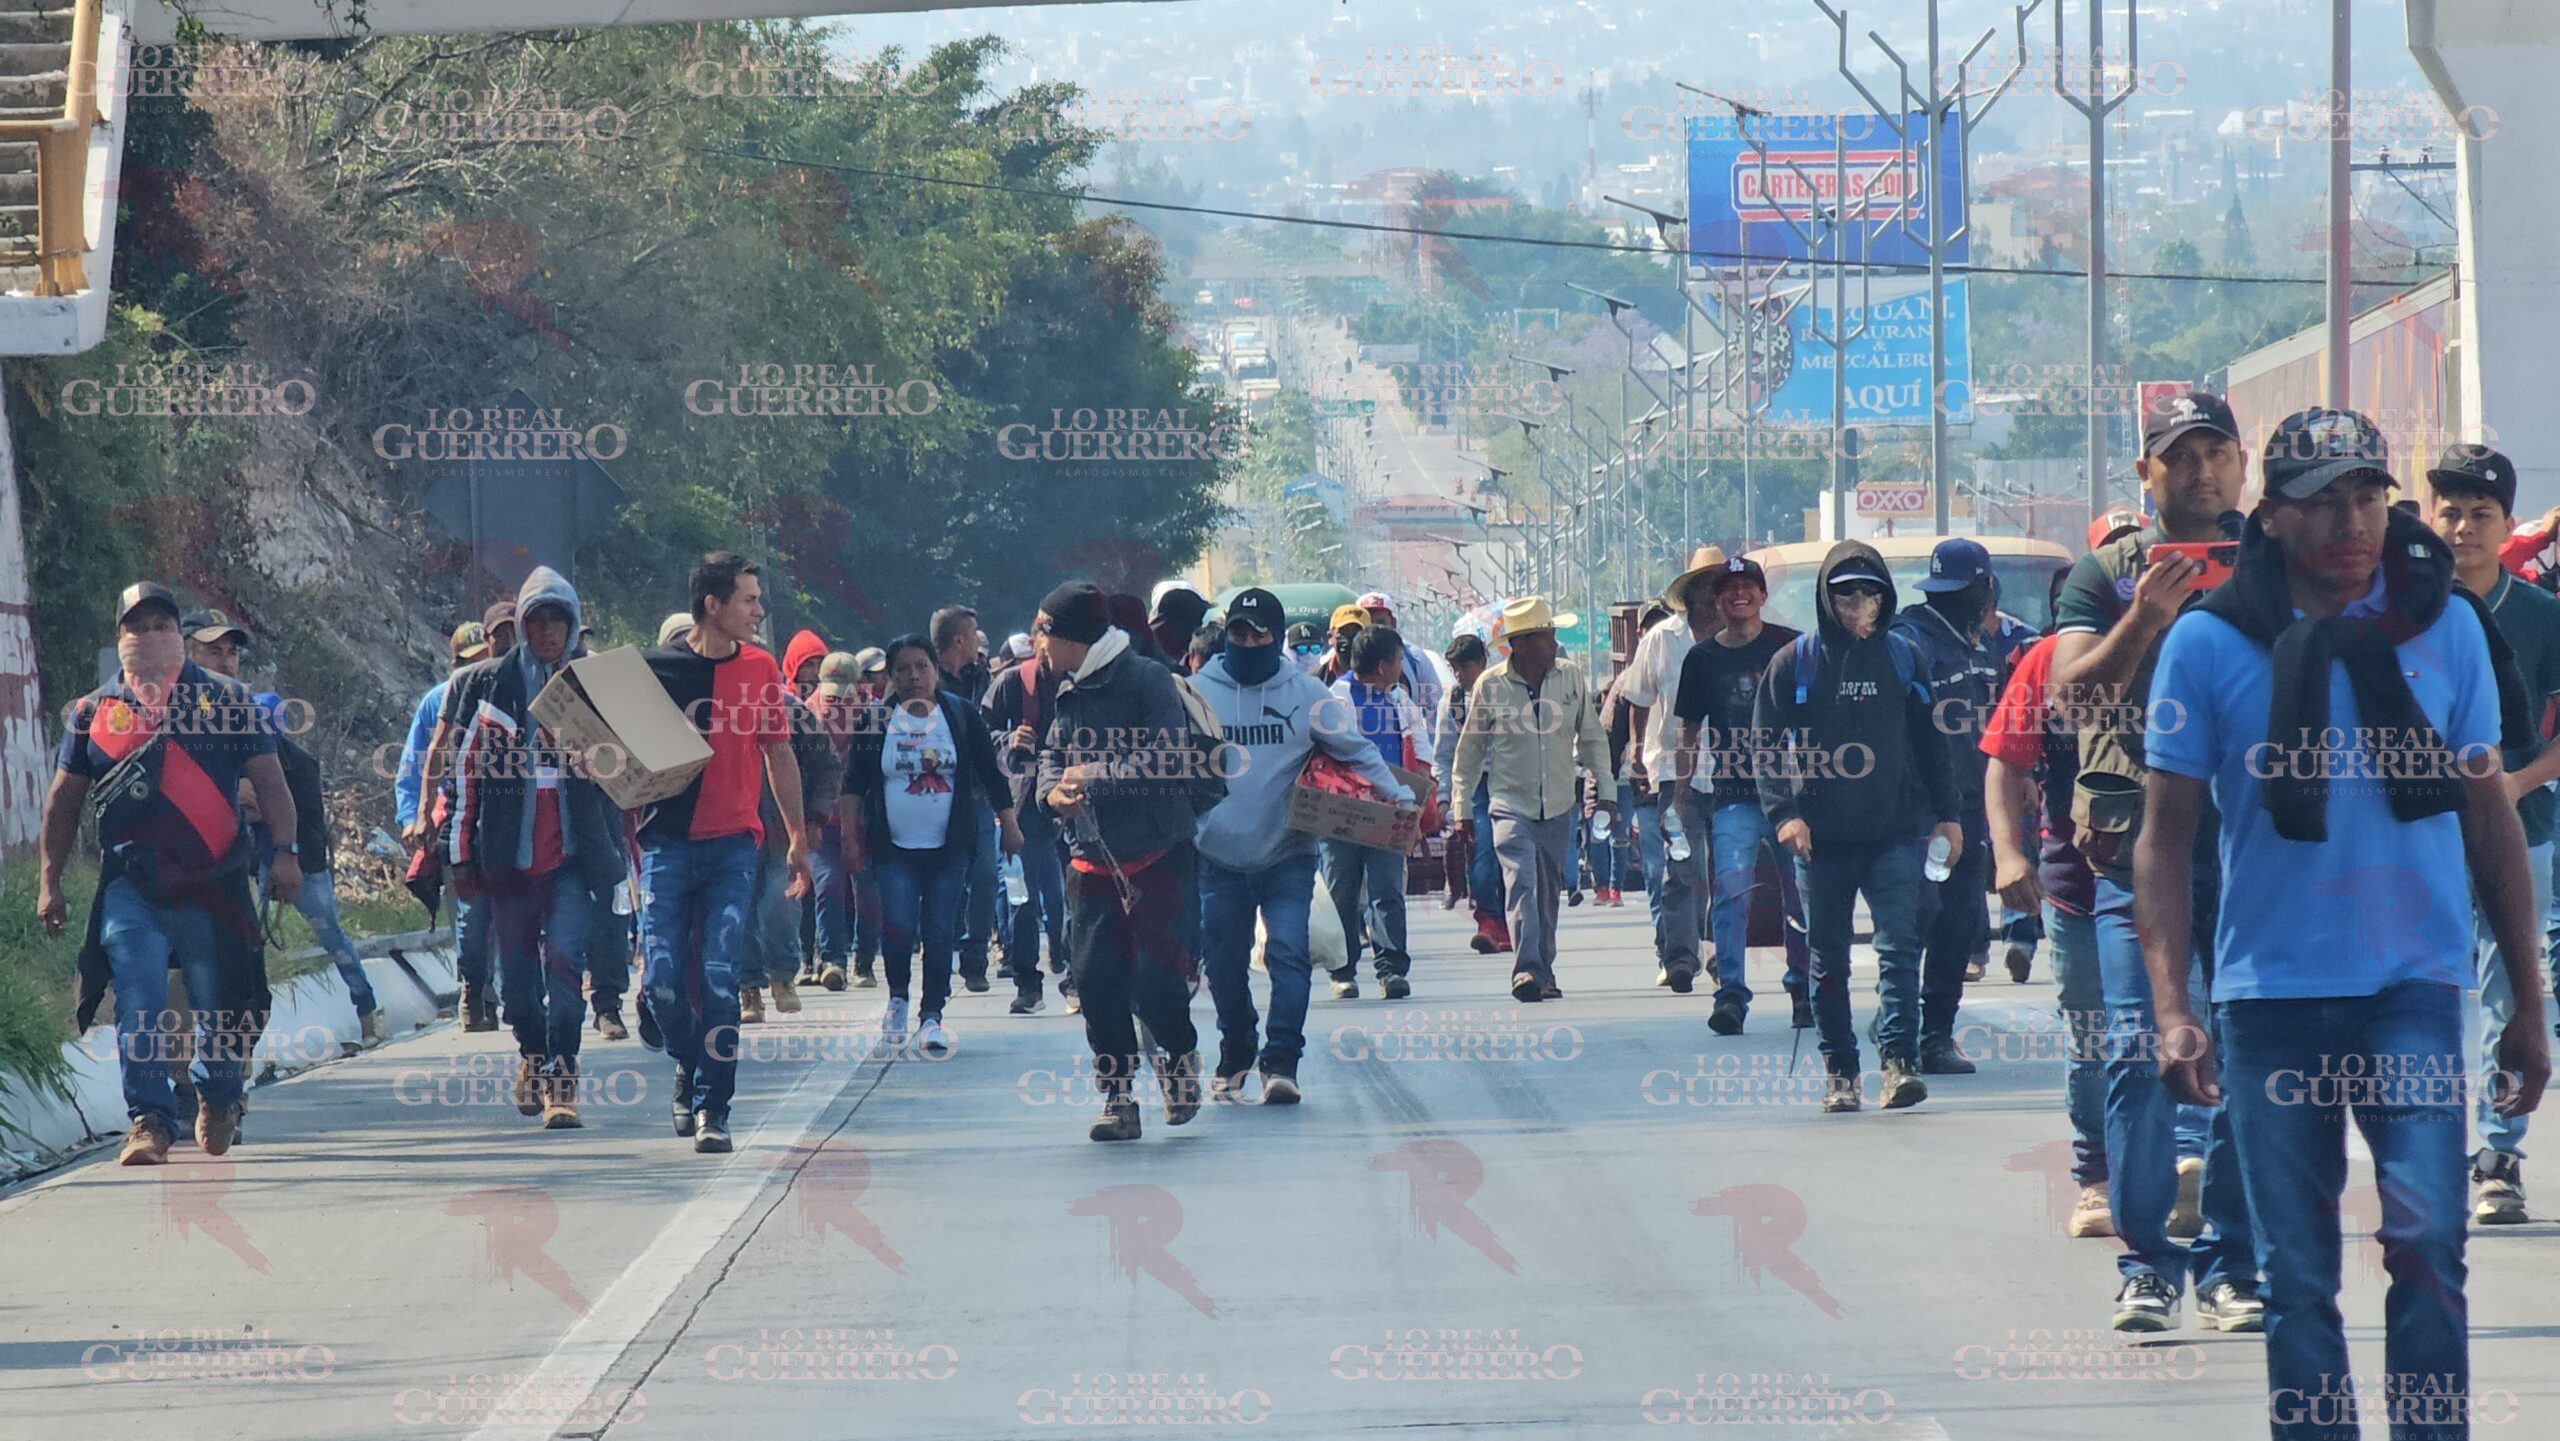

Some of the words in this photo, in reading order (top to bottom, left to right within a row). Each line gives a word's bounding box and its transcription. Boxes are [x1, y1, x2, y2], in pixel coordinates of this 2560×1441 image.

[1743, 174, 1912, 198] CARTELERASCOM
[1801, 325, 1947, 342] RTAURAN
[1873, 340, 1887, 352] &
[1801, 353, 1952, 370] MECALER
[1859, 490, 1922, 511] OXXO
[1729, 557, 1745, 573] LA
[1932, 552, 1943, 573] LA
[1242, 597, 1257, 607] LA
[1840, 688, 1878, 696] HILFGER
[1221, 724, 1284, 745] PUMA
